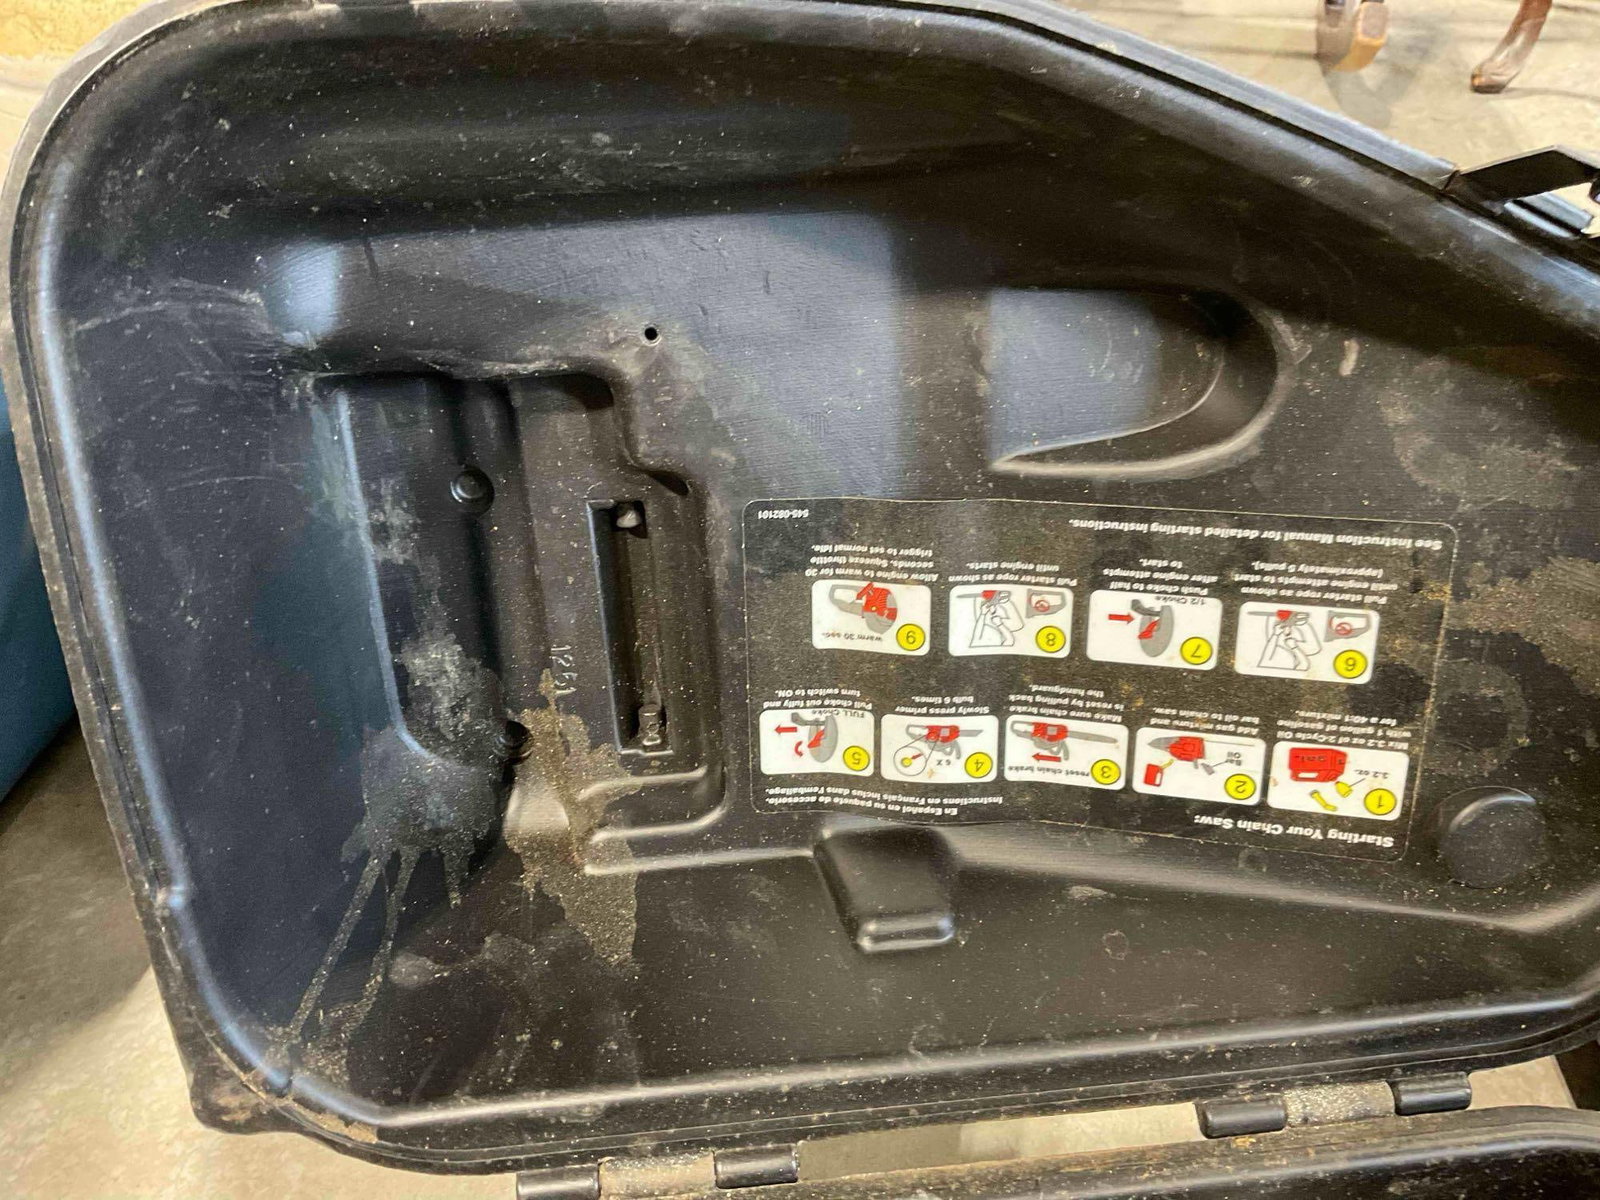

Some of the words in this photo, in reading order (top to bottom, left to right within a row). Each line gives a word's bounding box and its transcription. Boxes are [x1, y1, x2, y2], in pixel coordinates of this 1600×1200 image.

[1068, 518, 1149, 533] instructions.
[1150, 521, 1202, 536] starting
[1203, 526, 1260, 539] detailed
[1260, 529, 1282, 541] for
[1283, 531, 1335, 544] Manual
[1335, 534, 1413, 548] Instruction
[810, 543, 833, 553] idle.
[833, 543, 868, 553] normal
[869, 545, 885, 553] set
[1414, 539, 1443, 550] See
[886, 547, 898, 556] to
[899, 547, 933, 558] trigger
[809, 555, 847, 565] throttle
[847, 556, 889, 568] Squeeze
[1138, 558, 1169, 567] start.
[965, 561, 999, 570] starts.
[1000, 560, 1035, 571] engine
[1036, 563, 1060, 573] until
[1169, 561, 1183, 569] to
[1250, 560, 1288, 572] pulls).
[1287, 565, 1297, 574] 5
[804, 568, 819, 577] 30
[819, 568, 834, 577] for
[834, 567, 862, 576] warm
[863, 570, 875, 578] to
[875, 569, 910, 579] engine
[1102, 567, 1152, 579] attempts
[1297, 563, 1384, 579] (approximately
[910, 572, 939, 582] Allow
[948, 574, 981, 583] shown
[982, 573, 995, 581] as
[996, 572, 1020, 582] rope
[1020, 574, 1056, 583] starter
[1152, 571, 1190, 582] engine
[1190, 574, 1219, 584] after
[1233, 573, 1263, 583] start
[1263, 576, 1277, 584] to
[1277, 575, 1330, 587] attempts
[1056, 578, 1078, 587] Pull
[1109, 581, 1132, 591] half
[1132, 583, 1145, 591] to
[1330, 580, 1370, 589] engine
[1370, 582, 1399, 591] until
[1146, 583, 1180, 593] choke
[1180, 586, 1209, 596] Push
[1240, 586, 1279, 596] shown
[1295, 589, 1322, 598] rope
[1323, 593, 1364, 602] starter
[1154, 595, 1188, 605] Choke
[1190, 597, 1206, 605] 1/2
[1363, 595, 1388, 605] Pull
[906, 630, 917, 645] 9
[1045, 632, 1057, 647] 8
[1191, 644, 1202, 659] 7
[1344, 657, 1357, 672] 6
[774, 689, 794, 697] ON.
[794, 689, 806, 697] to
[807, 688, 840, 698] switch
[841, 688, 861, 698] turn
[1028, 684, 1085, 697] handguard.
[1086, 689, 1104, 698] the
[805, 699, 822, 707] out
[823, 698, 853, 707] choke
[911, 696, 942, 704] times.
[943, 696, 951, 704] 6
[952, 696, 974, 704] bulb
[1008, 694, 1033, 703] back
[1035, 694, 1069, 706] pulling
[1070, 698, 1084, 708] by
[762, 700, 782, 709] and
[782, 699, 804, 708] fully
[854, 700, 872, 710] Pull
[1084, 701, 1113, 710] reset
[1113, 703, 1124, 712] is
[894, 705, 928, 714] primer
[928, 704, 956, 713] press
[957, 705, 990, 715] Slowly
[1008, 705, 1038, 714] brake
[1039, 708, 1068, 717] chain
[1152, 707, 1178, 715] saw.
[842, 709, 865, 719] FULL
[1069, 710, 1092, 718] sure
[1093, 713, 1122, 722] Make
[1178, 709, 1209, 718] chain
[1211, 713, 1223, 721] to
[1295, 710, 1342, 721] mixture.
[1150, 718, 1171, 726] and
[1224, 714, 1239, 723] oil
[1241, 716, 1260, 725] bar
[1344, 714, 1368, 724] 40:1
[1369, 717, 1379, 725] a
[1379, 718, 1397, 727] for
[1215, 724, 1236, 732] gas
[1277, 719, 1324, 729] gasoline
[1325, 724, 1338, 732] of
[1236, 726, 1259, 735] Add
[1276, 730, 1293, 739] Oil
[1339, 726, 1375, 735] gallon
[1377, 728, 1384, 737] 1
[1386, 729, 1412, 738] with
[1338, 736, 1351, 744] of
[1352, 737, 1366, 745] oz
[1367, 739, 1386, 748] 3.2
[1388, 741, 1409, 750] Mix
[851, 751, 862, 766] 5
[974, 759, 985, 773] 4
[1036, 766, 1063, 775] chain
[1065, 769, 1090, 777] reset
[1100, 765, 1112, 779] 3
[825, 787, 850, 796] dans
[1235, 780, 1247, 794] 2
[851, 789, 881, 800] inclus
[818, 796, 832, 805] de
[832, 797, 872, 808] paquete
[882, 794, 926, 805] Français
[927, 798, 941, 806] en
[942, 796, 1003, 806] Instructions
[1376, 794, 1385, 809] 1
[887, 804, 900, 812] en
[902, 806, 942, 816] Español
[944, 807, 958, 816] En
[1194, 815, 1234, 829] Saw:
[1237, 820, 1284, 835] Chain
[1286, 826, 1323, 839] Your
[1327, 829, 1394, 848] Starting
